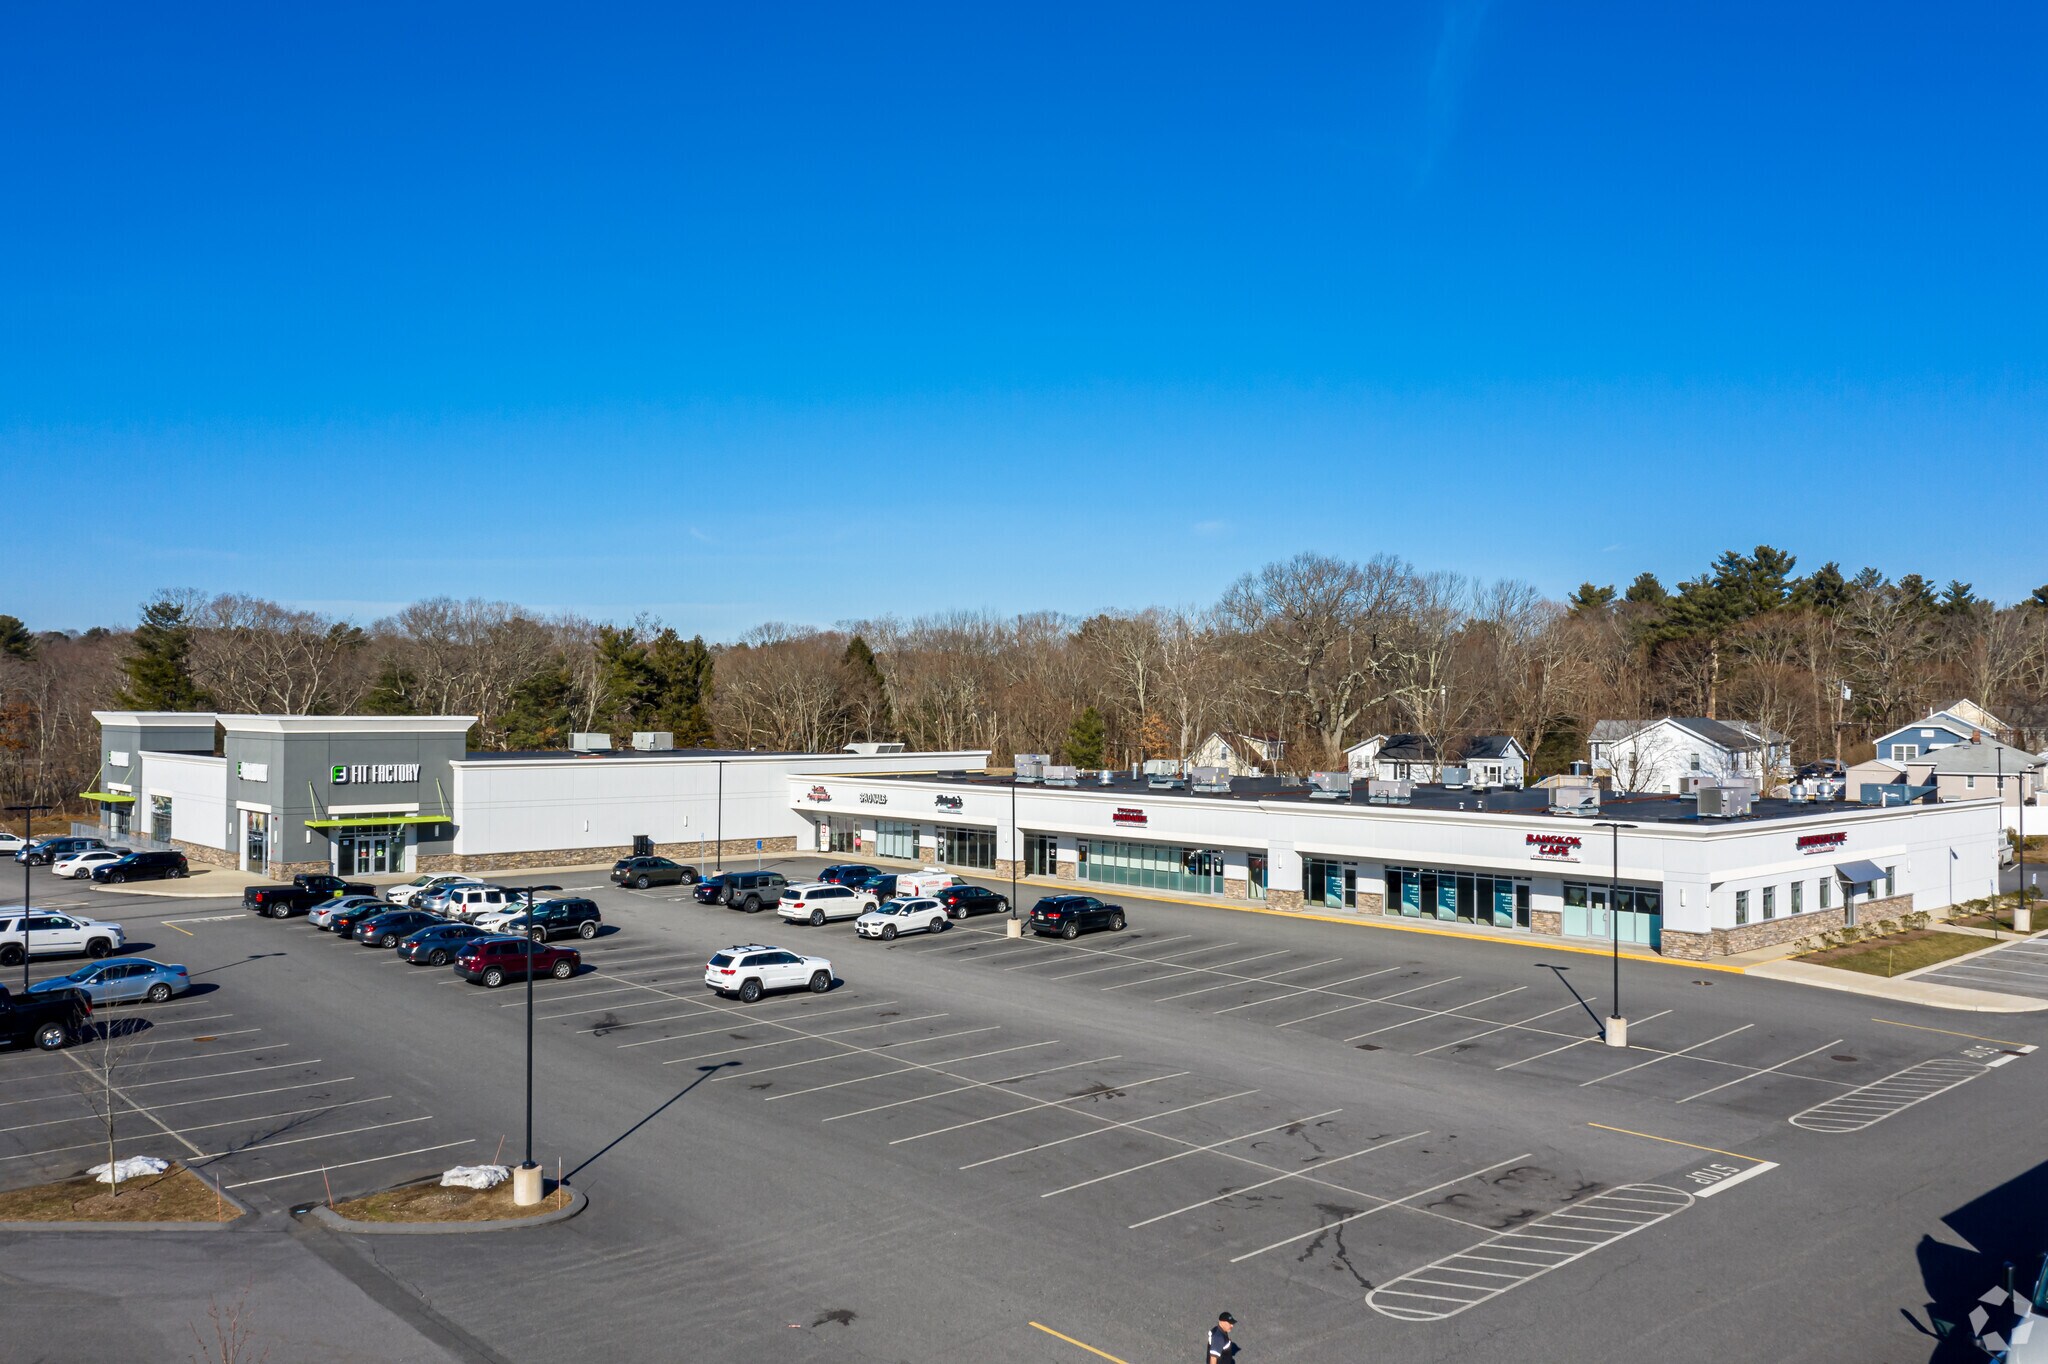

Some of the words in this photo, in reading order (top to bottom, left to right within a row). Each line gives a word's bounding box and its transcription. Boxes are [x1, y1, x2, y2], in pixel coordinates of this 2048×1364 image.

[351, 764, 369, 783] FIT
[372, 763, 420, 783] FACTORY
[1526, 833, 1582, 846] BANGKOK
[1539, 844, 1570, 856] CAFE
[1685, 1163, 1740, 1185] STOP
